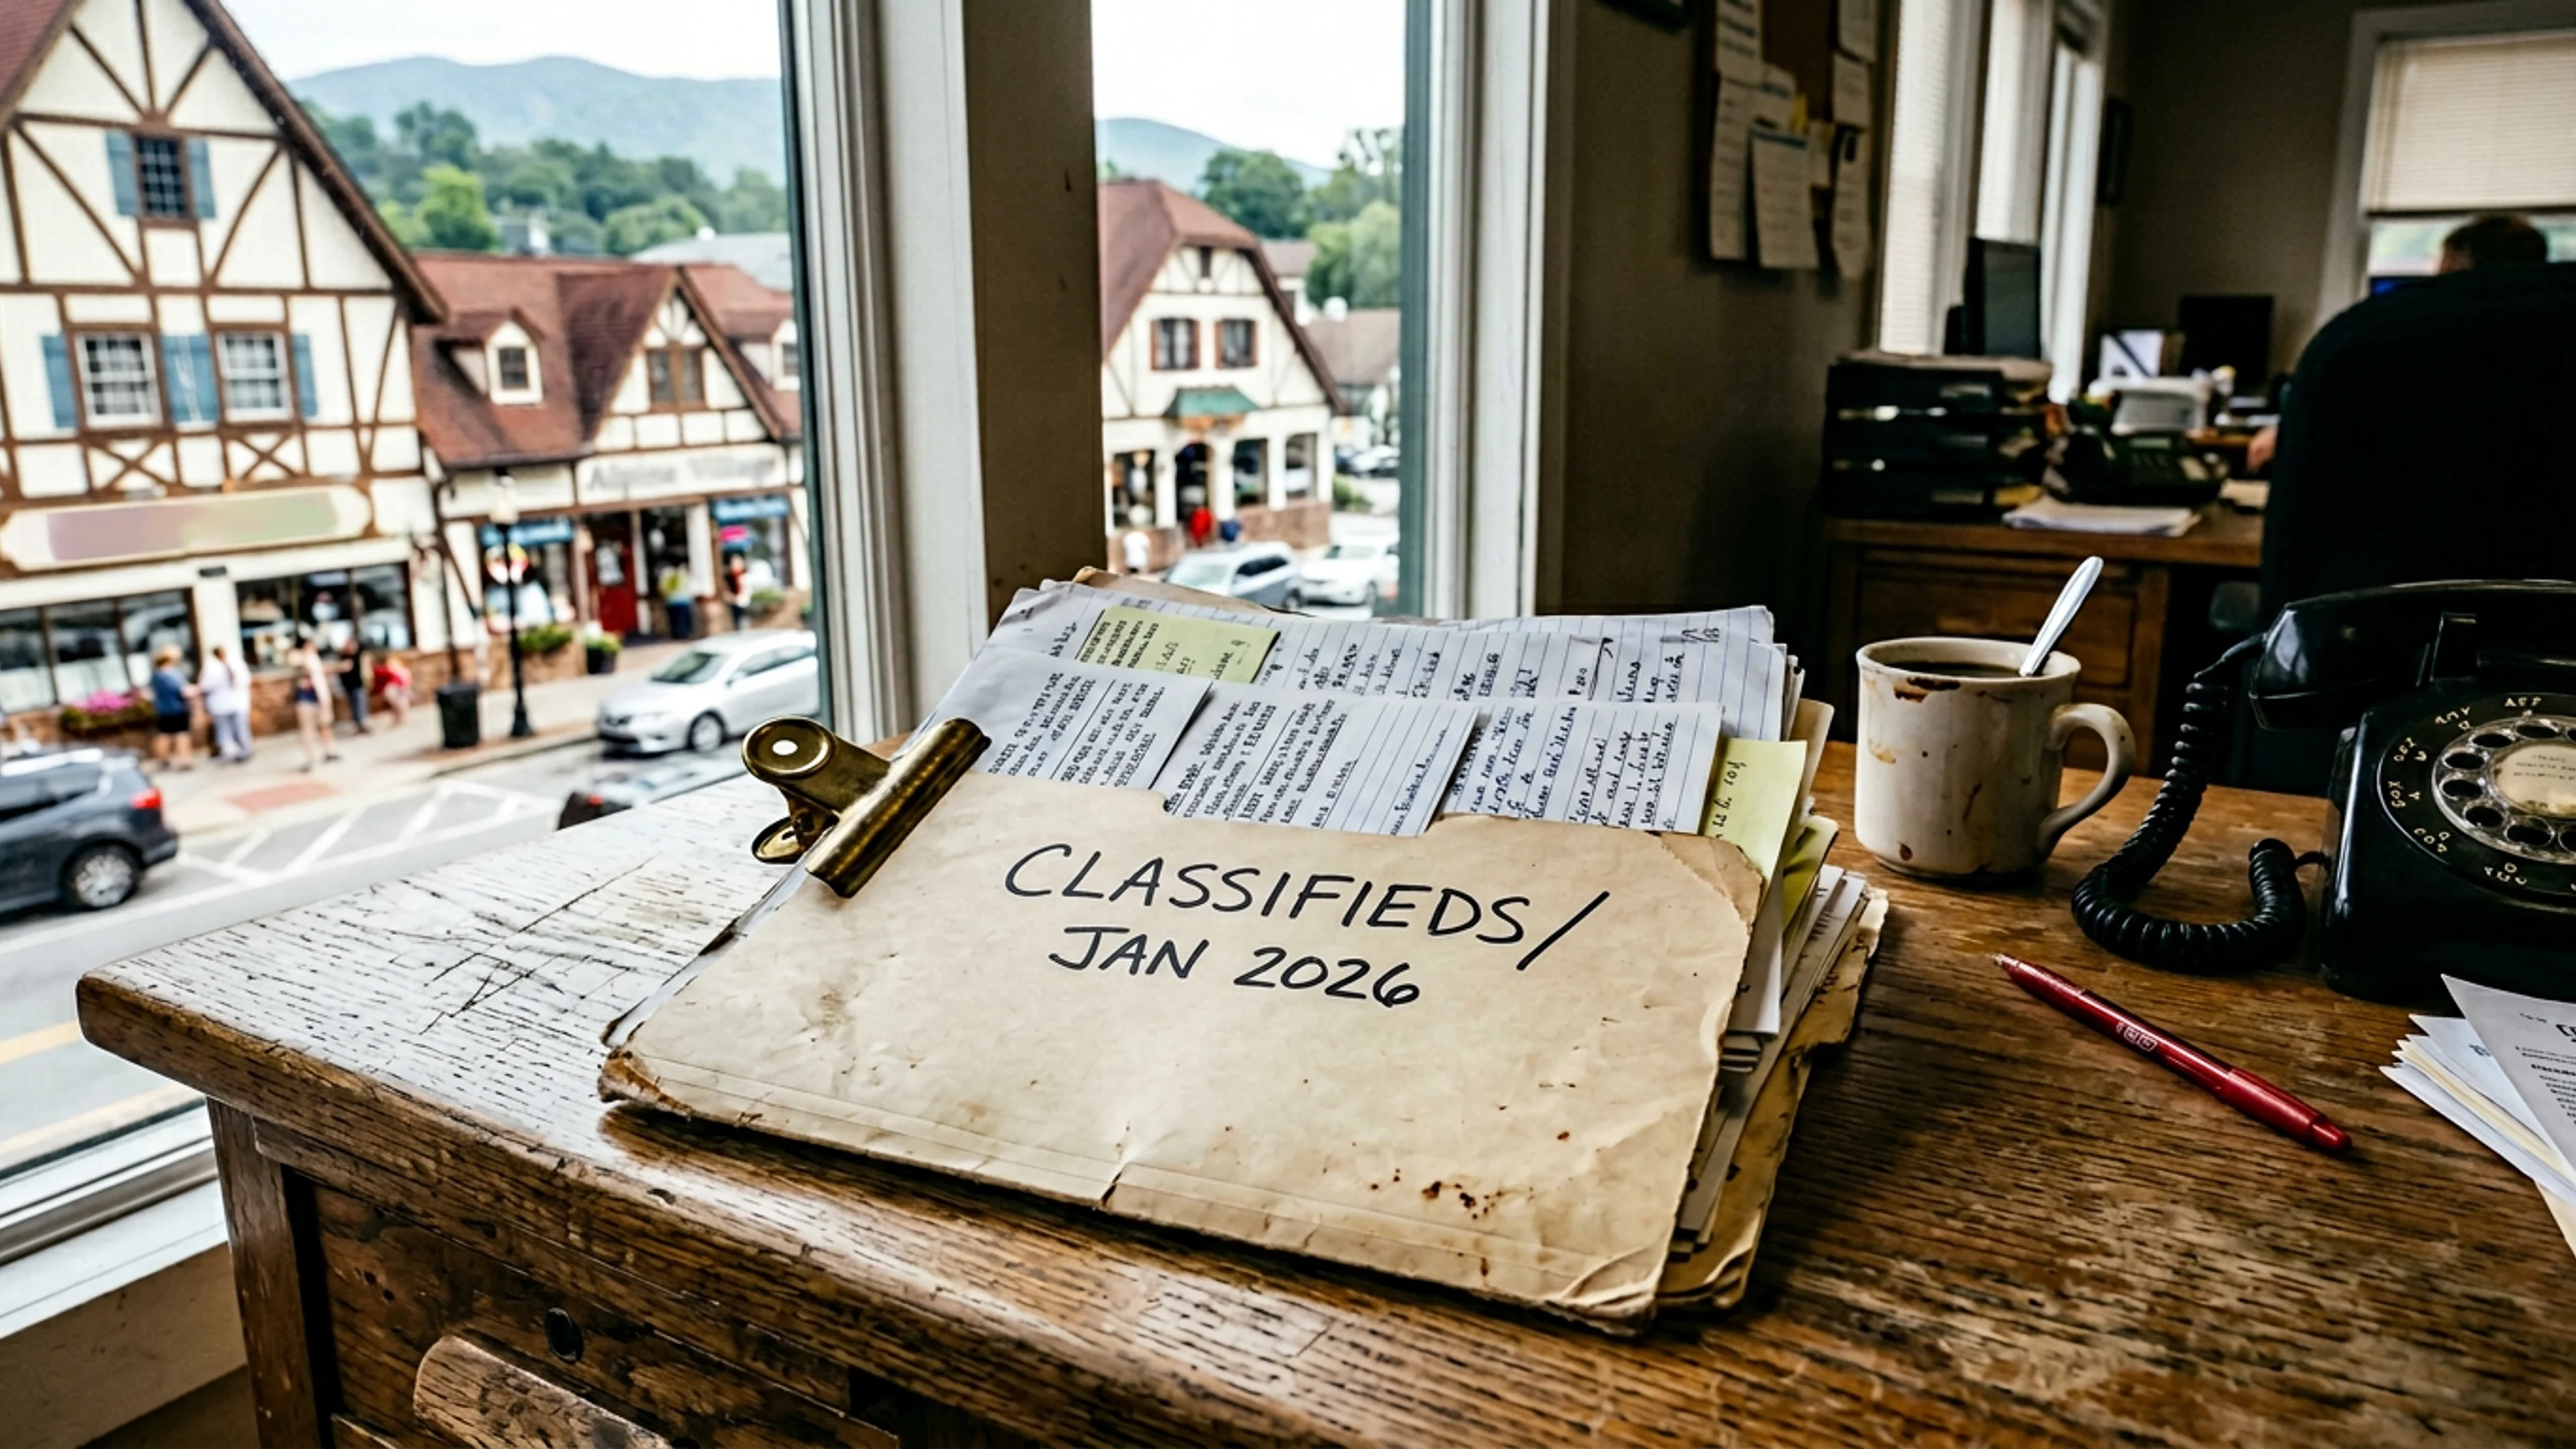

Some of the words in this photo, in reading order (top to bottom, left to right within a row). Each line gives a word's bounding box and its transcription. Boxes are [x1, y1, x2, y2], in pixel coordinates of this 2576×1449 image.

[1006, 844, 1610, 971] CLASSIFIEDS/
[1049, 927, 1210, 978] JAN
[1234, 947, 1419, 1008] 2026
